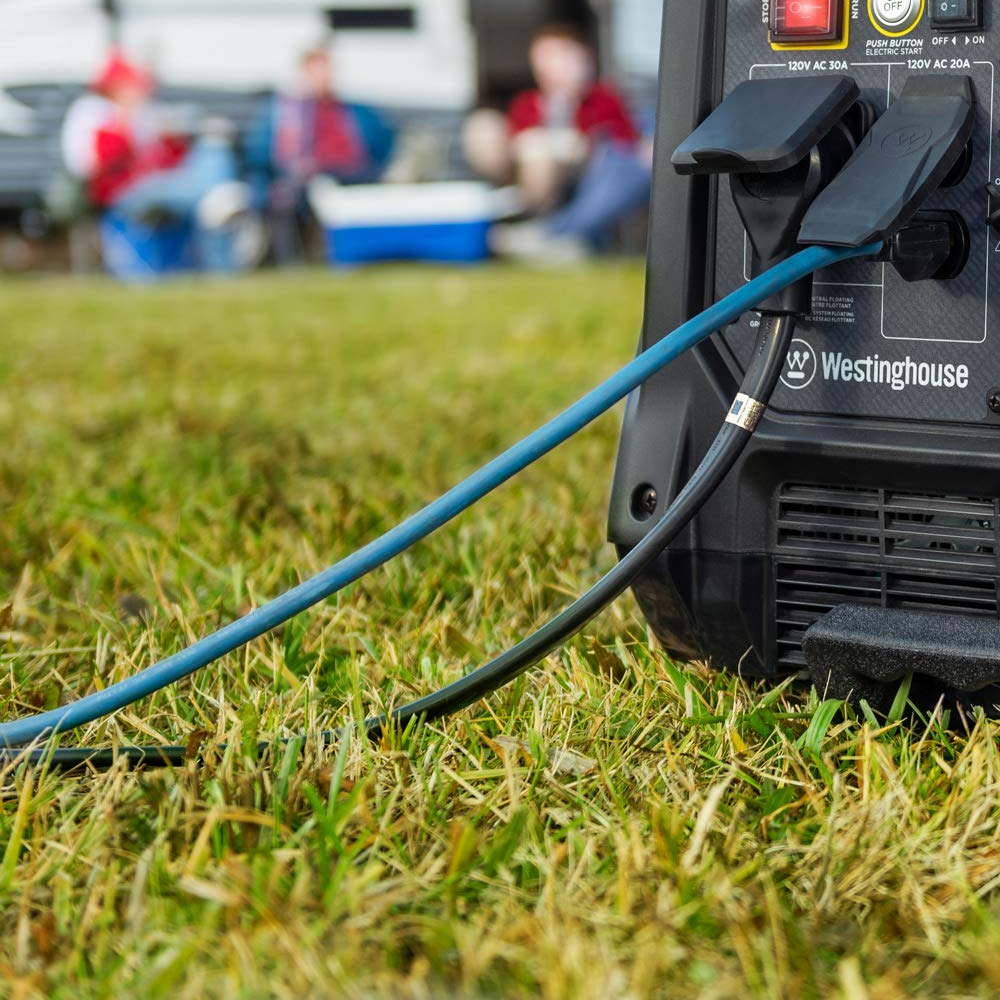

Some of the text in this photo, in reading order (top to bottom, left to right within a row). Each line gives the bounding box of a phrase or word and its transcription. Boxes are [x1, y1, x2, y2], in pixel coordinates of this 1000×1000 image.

[884, 1, 902, 11] OFF
[866, 39, 923, 48] PUSH BUTTON
[932, 36, 984, 45] OFF ON
[788, 61, 848, 70] 120V AC 30A
[907, 59, 970, 69] 120V AC 20A
[822, 352, 968, 390] Westinghouse
